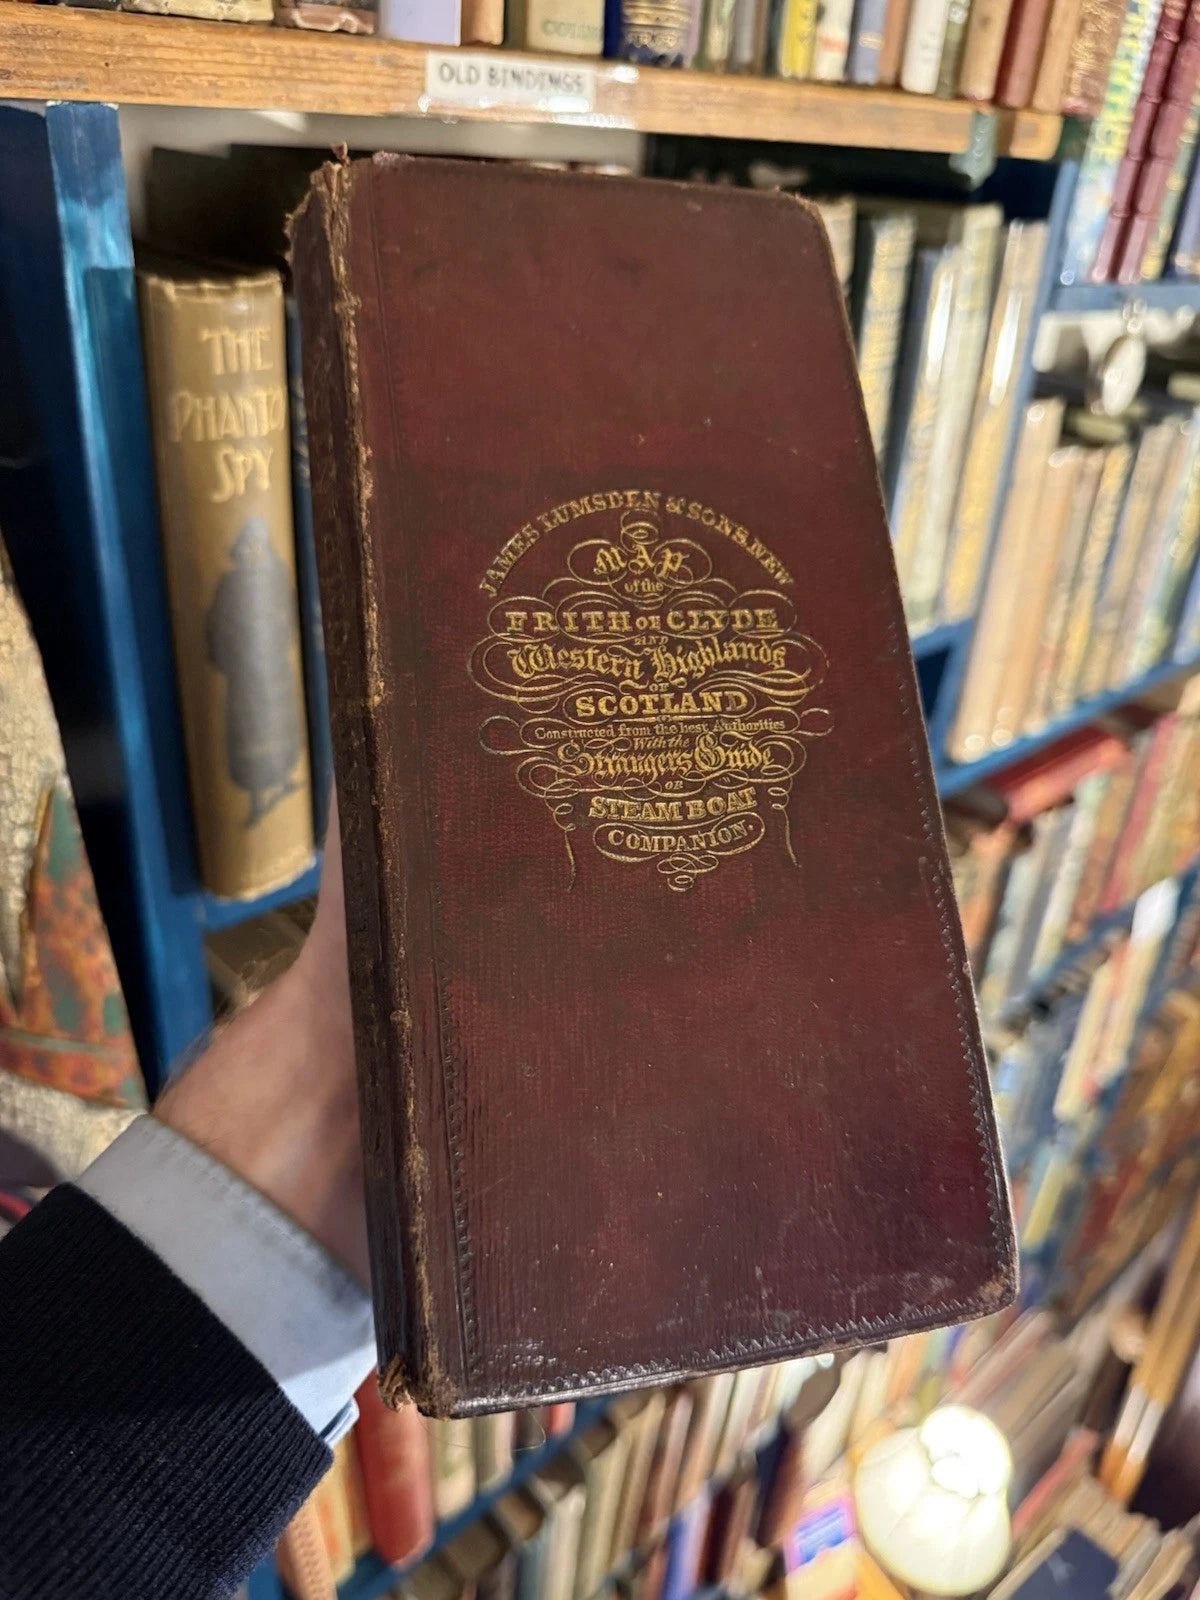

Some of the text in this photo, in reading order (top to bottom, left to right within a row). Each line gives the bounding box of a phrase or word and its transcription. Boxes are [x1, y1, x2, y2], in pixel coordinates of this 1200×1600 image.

[439, 62, 584, 93] OLD BINDINGS
[201, 326, 274, 376] THE
[211, 448, 273, 502] SPY
[479, 522, 540, 598] JAMES
[536, 490, 661, 533] LUMSDEN
[665, 497, 686, 514] &
[746, 537, 794, 585] NEW
[624, 578, 664, 593] of the
[505, 608, 778, 633] FRITH OF CLYDE
[507, 636, 786, 687] Western Highlands
[649, 682, 670, 692] OF
[575, 691, 748, 718] SCOTLAND
[534, 717, 786, 740] Constructed from the best Authorities
[633, 735, 690, 749] With the
[694, 731, 774, 771] Guide
[665, 780, 684, 790] OR
[588, 787, 757, 822] STEAM BOAT
